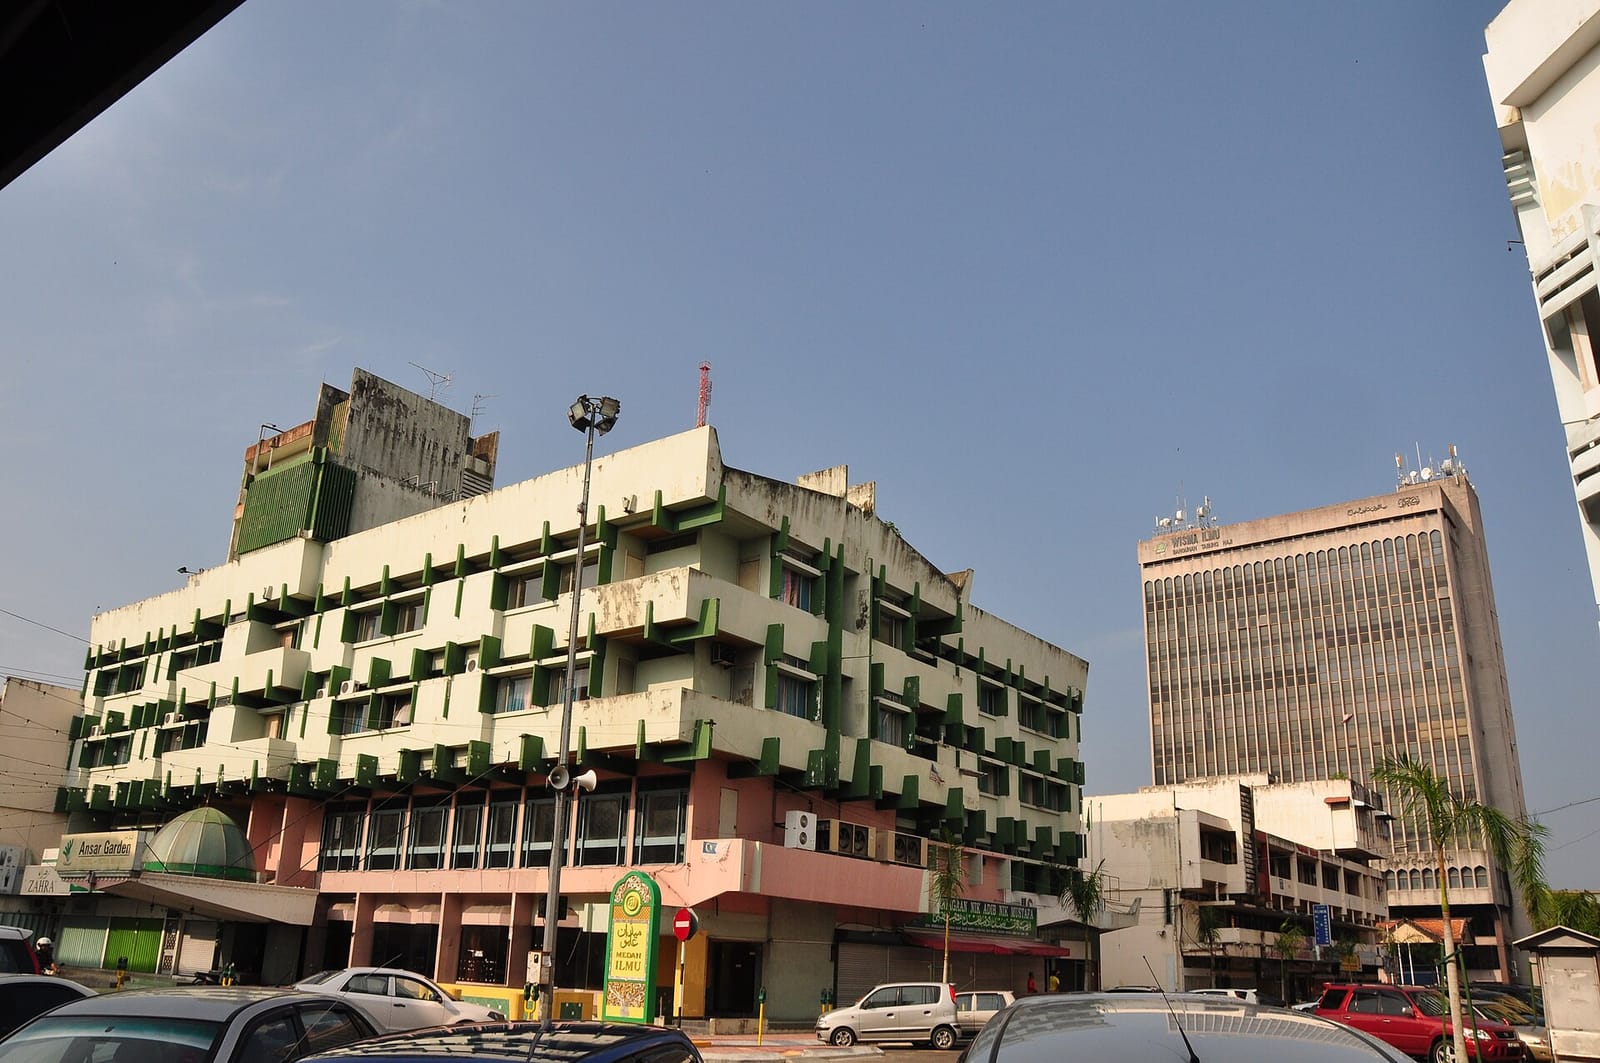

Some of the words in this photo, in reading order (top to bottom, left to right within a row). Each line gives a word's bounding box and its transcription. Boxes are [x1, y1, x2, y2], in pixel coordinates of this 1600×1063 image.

[1171, 533, 1199, 549] WISMA
[1201, 528, 1221, 542] ILMU
[78, 841, 102, 855] Ansar
[103, 840, 132, 854] Garden
[27, 880, 55, 893] ZAHRA
[616, 951, 642, 960] MEDAN
[615, 960, 642, 972] ILMU
